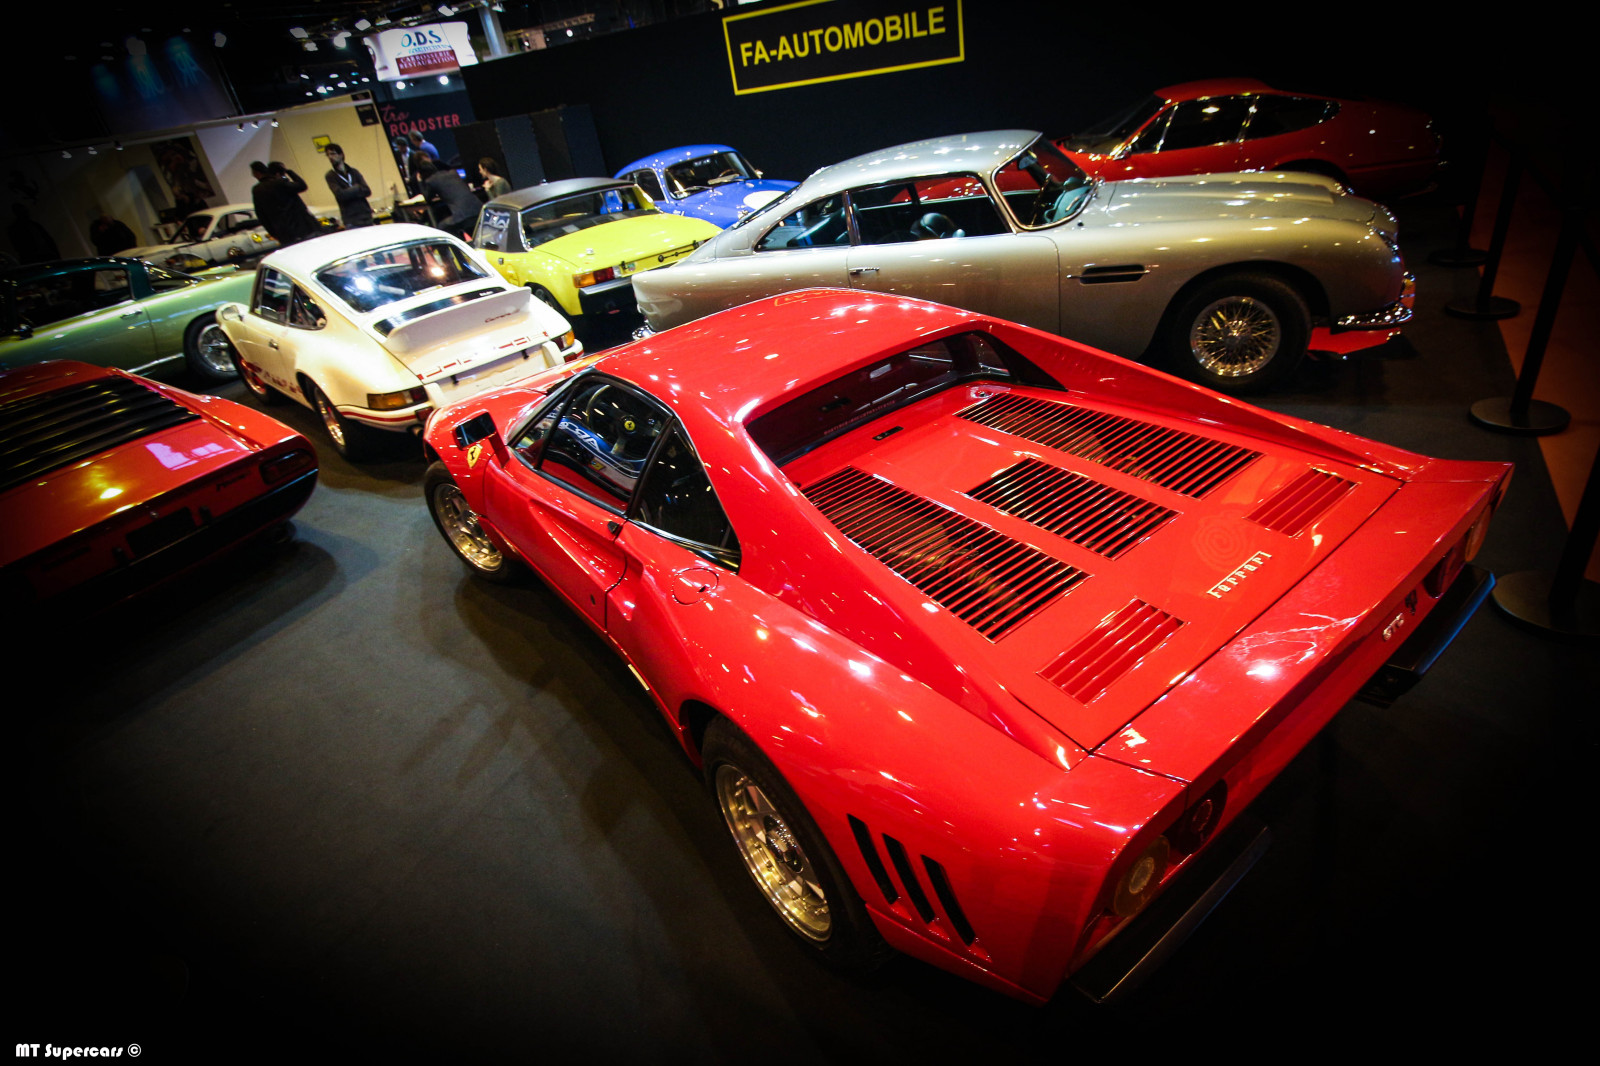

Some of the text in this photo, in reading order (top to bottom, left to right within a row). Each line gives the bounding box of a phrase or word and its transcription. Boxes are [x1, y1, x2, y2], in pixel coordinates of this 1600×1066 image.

[740, 6, 946, 67] FA-AUTOMOBILE
[389, 113, 461, 137] ROADSTER
[1206, 550, 1272, 598] Ferrari
